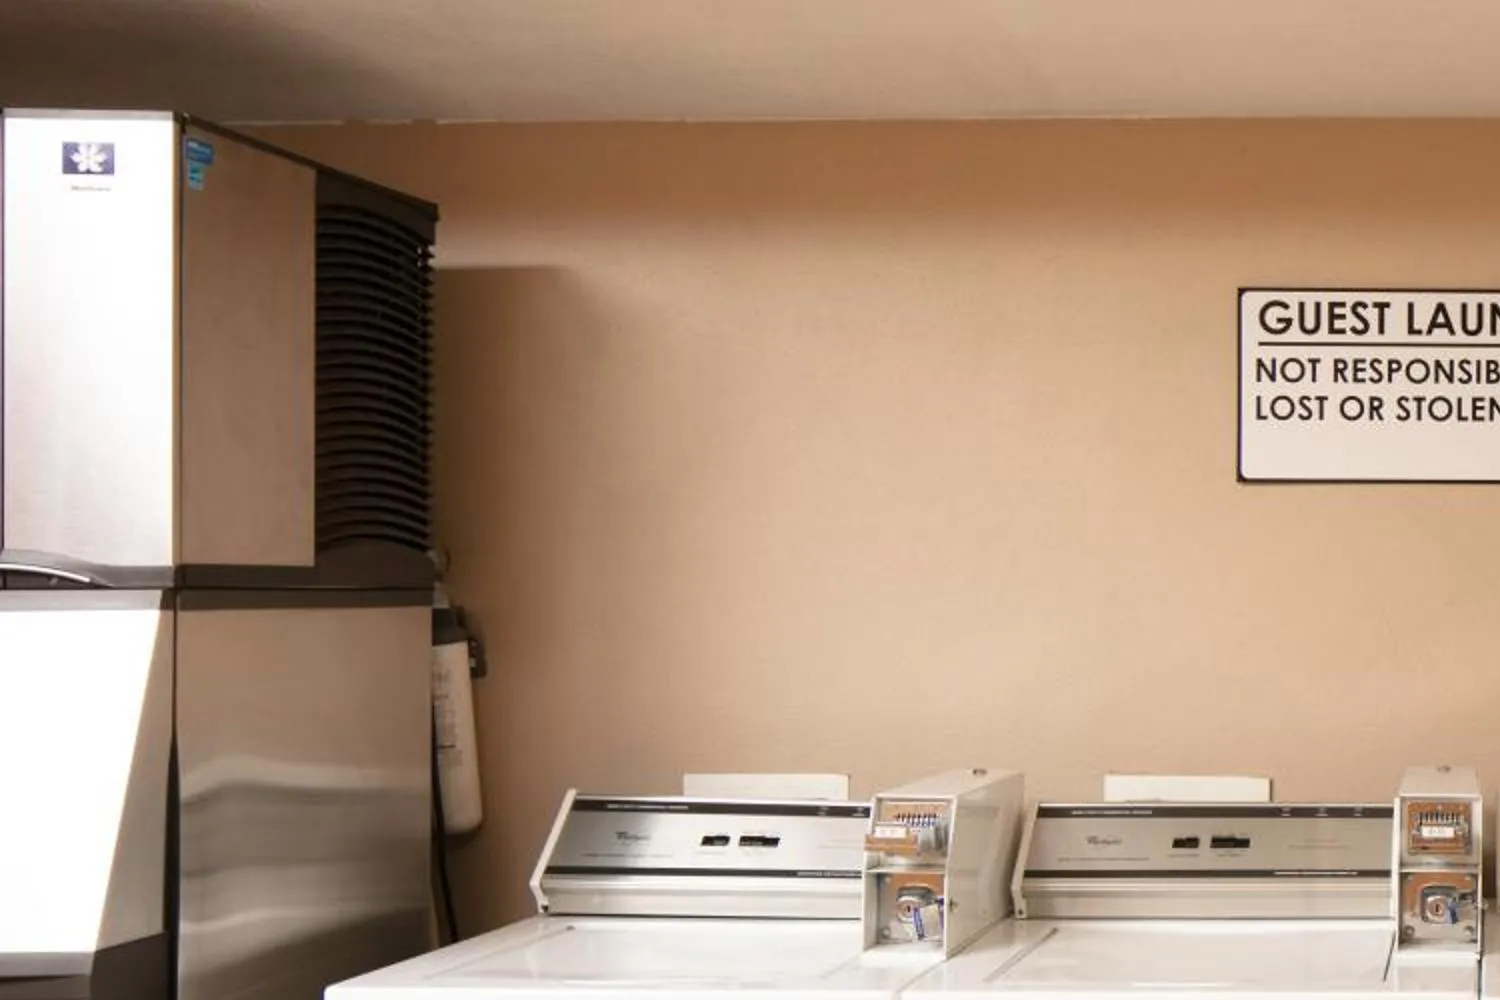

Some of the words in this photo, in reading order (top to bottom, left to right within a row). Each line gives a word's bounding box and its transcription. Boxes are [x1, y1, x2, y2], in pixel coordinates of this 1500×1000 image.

[1259, 300, 1391, 335] GUEST
[1256, 358, 1321, 383] NOT
[1256, 396, 1328, 420] LOST
[1340, 396, 1384, 421] OR
